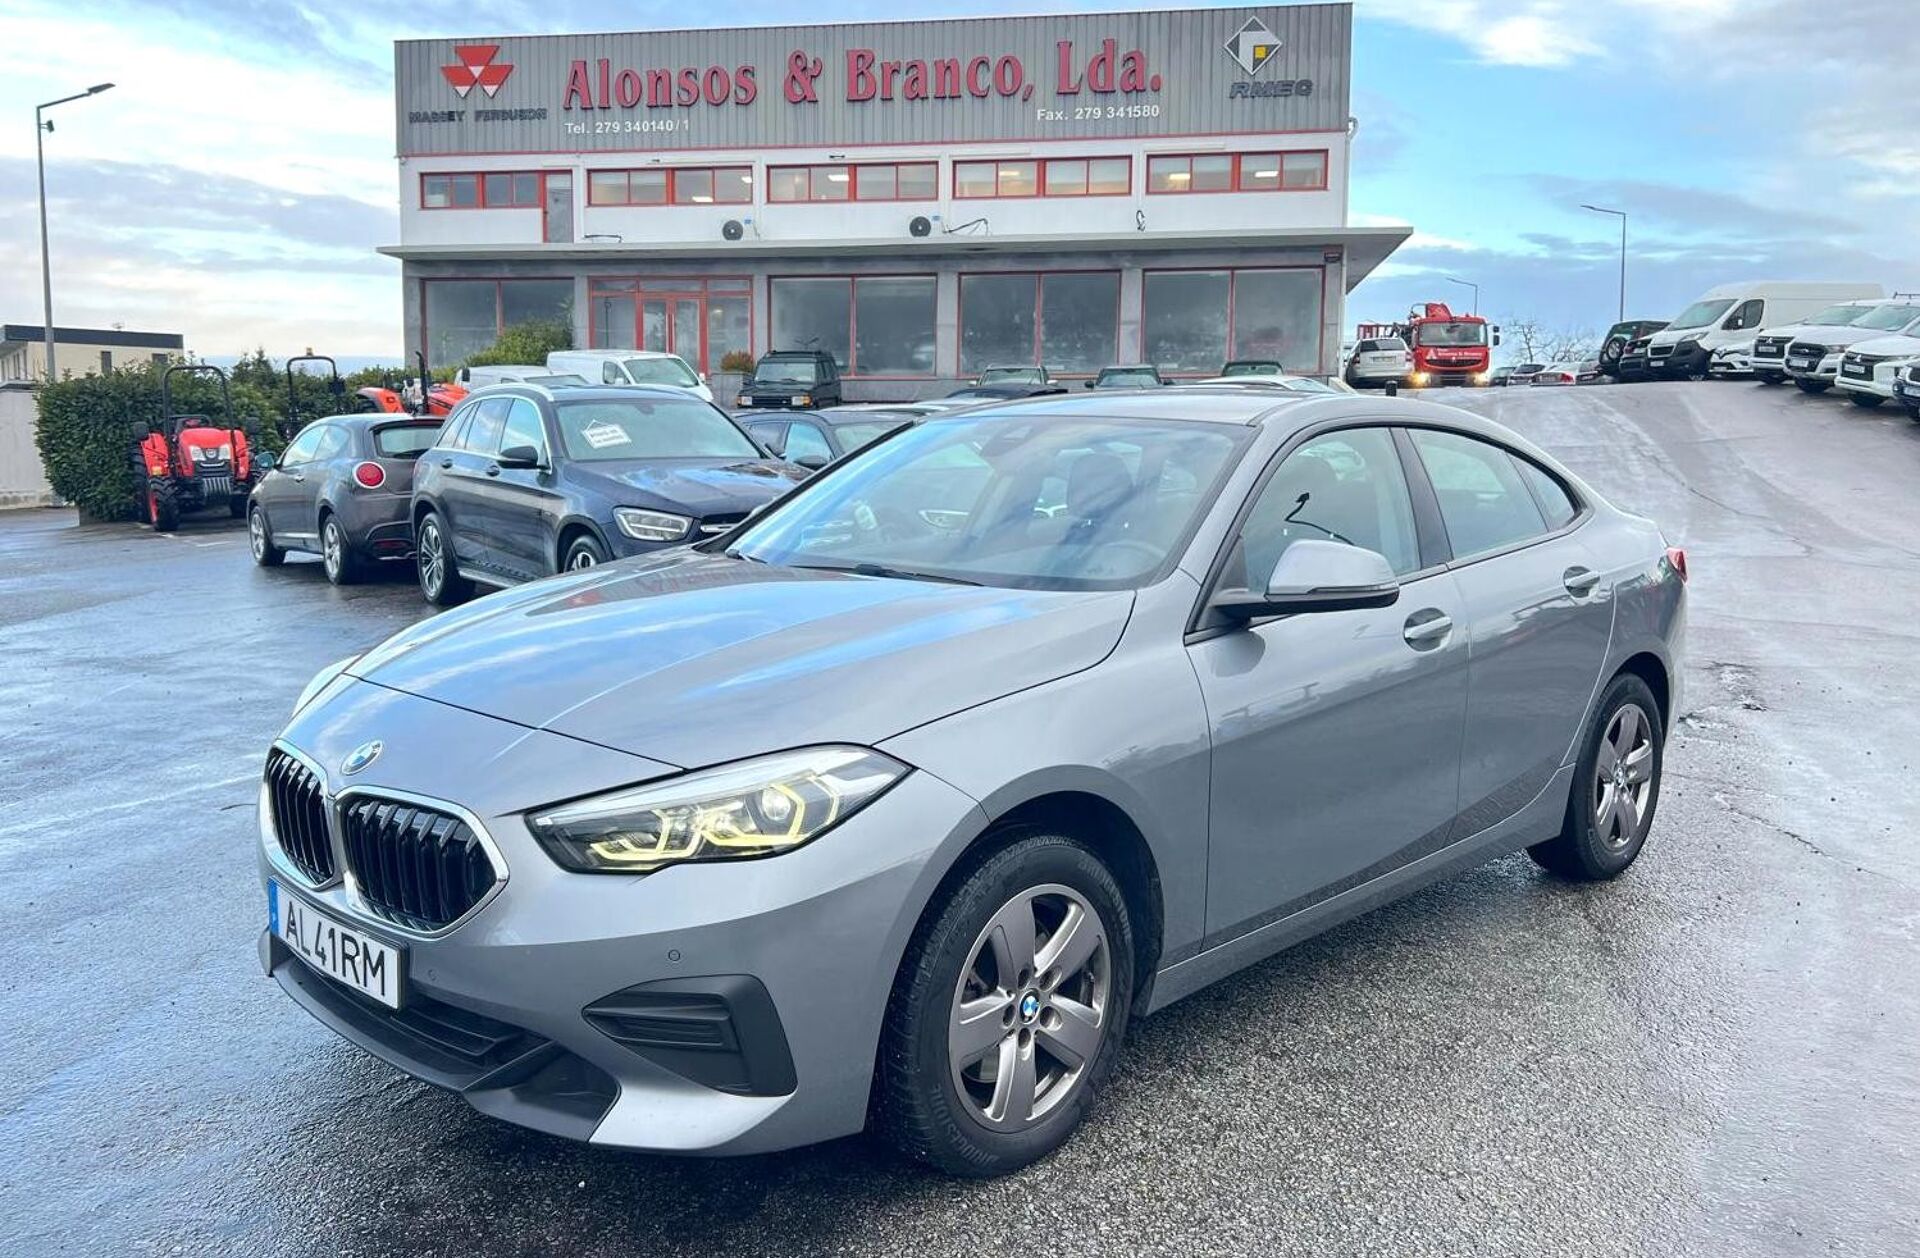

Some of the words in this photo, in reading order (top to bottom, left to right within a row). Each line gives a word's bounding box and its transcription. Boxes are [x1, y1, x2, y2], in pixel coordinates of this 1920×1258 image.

[563, 58, 758, 110] Alonsos
[784, 50, 823, 103] &
[846, 48, 1034, 103] Branco,
[1056, 38, 1162, 95] Lda.
[409, 110, 465, 123] MASSEY
[1037, 109, 1068, 121] Fax.
[1074, 108, 1101, 120] 279
[1107, 105, 1159, 118] 341580
[563, 122, 590, 134] Tel.
[595, 121, 620, 133] 279
